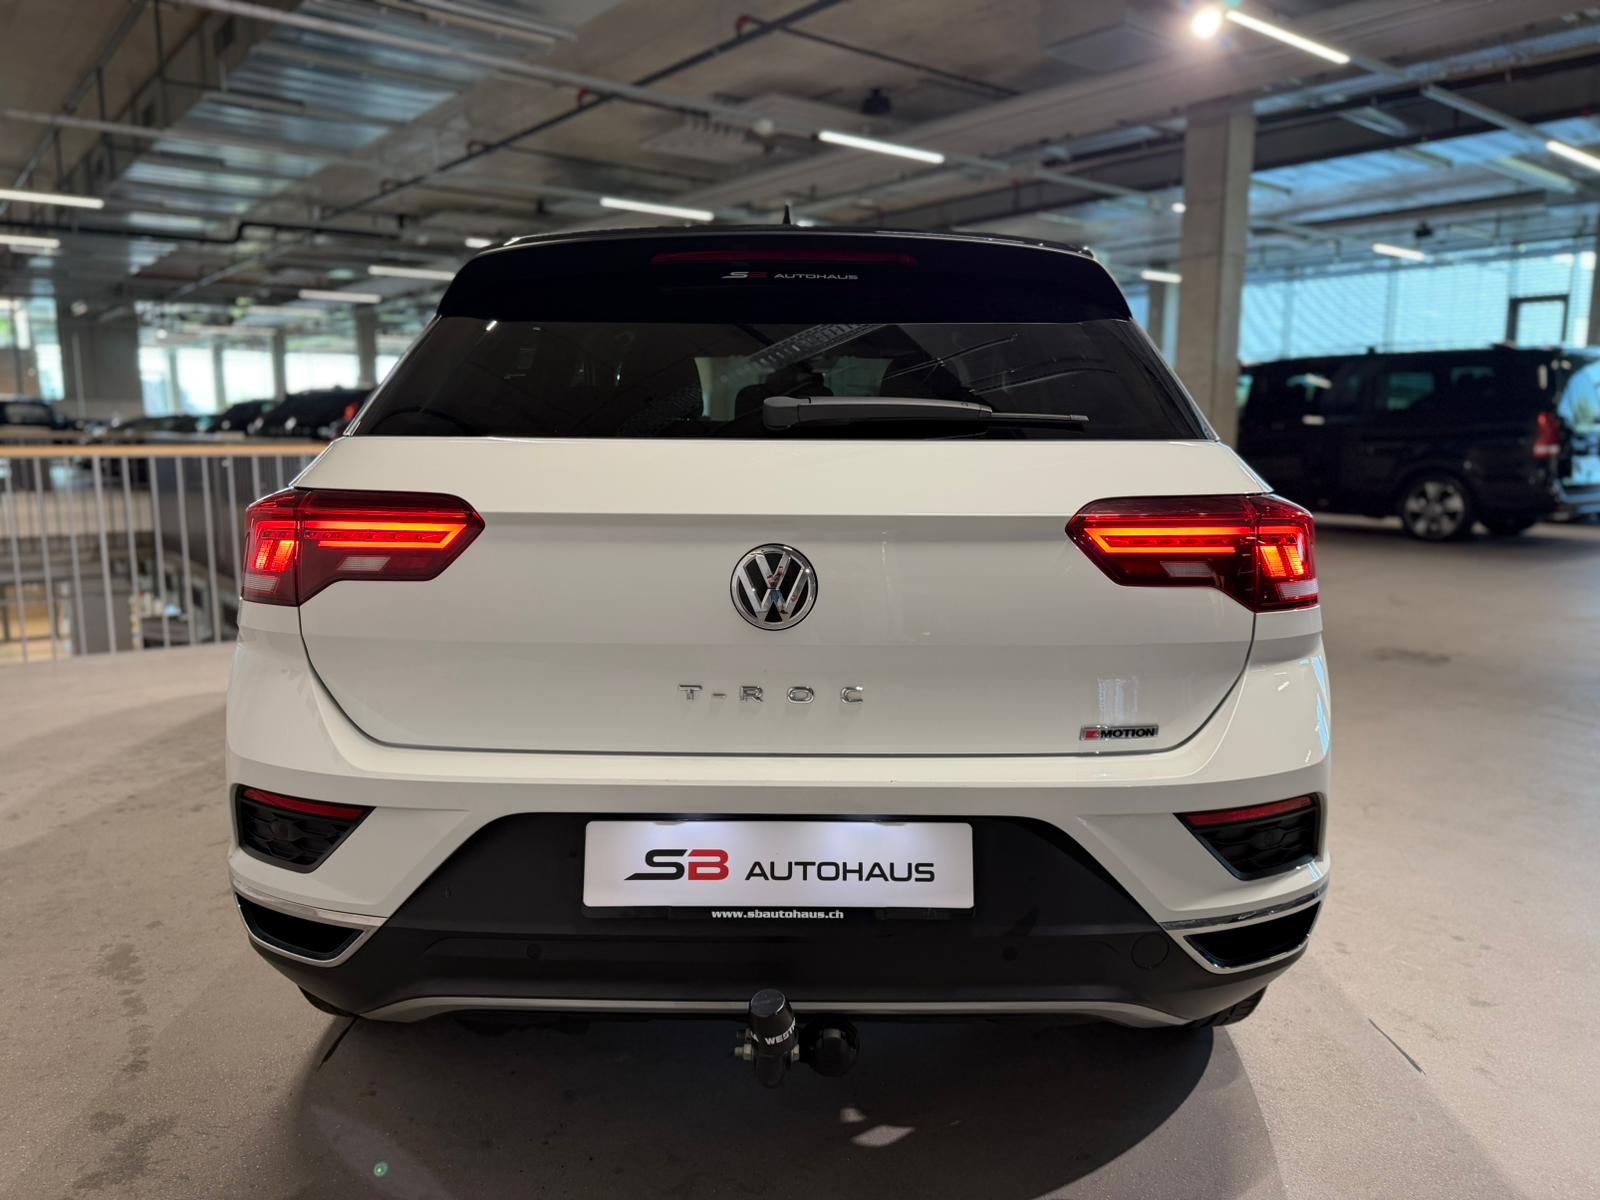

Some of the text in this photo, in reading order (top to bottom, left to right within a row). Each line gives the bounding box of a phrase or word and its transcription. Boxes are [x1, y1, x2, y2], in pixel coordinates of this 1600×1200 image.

[679, 685, 863, 704] T-ROC
[624, 849, 935, 882] SB AUTOHAUS
[711, 909, 844, 919] www.sbautohaus.ch
